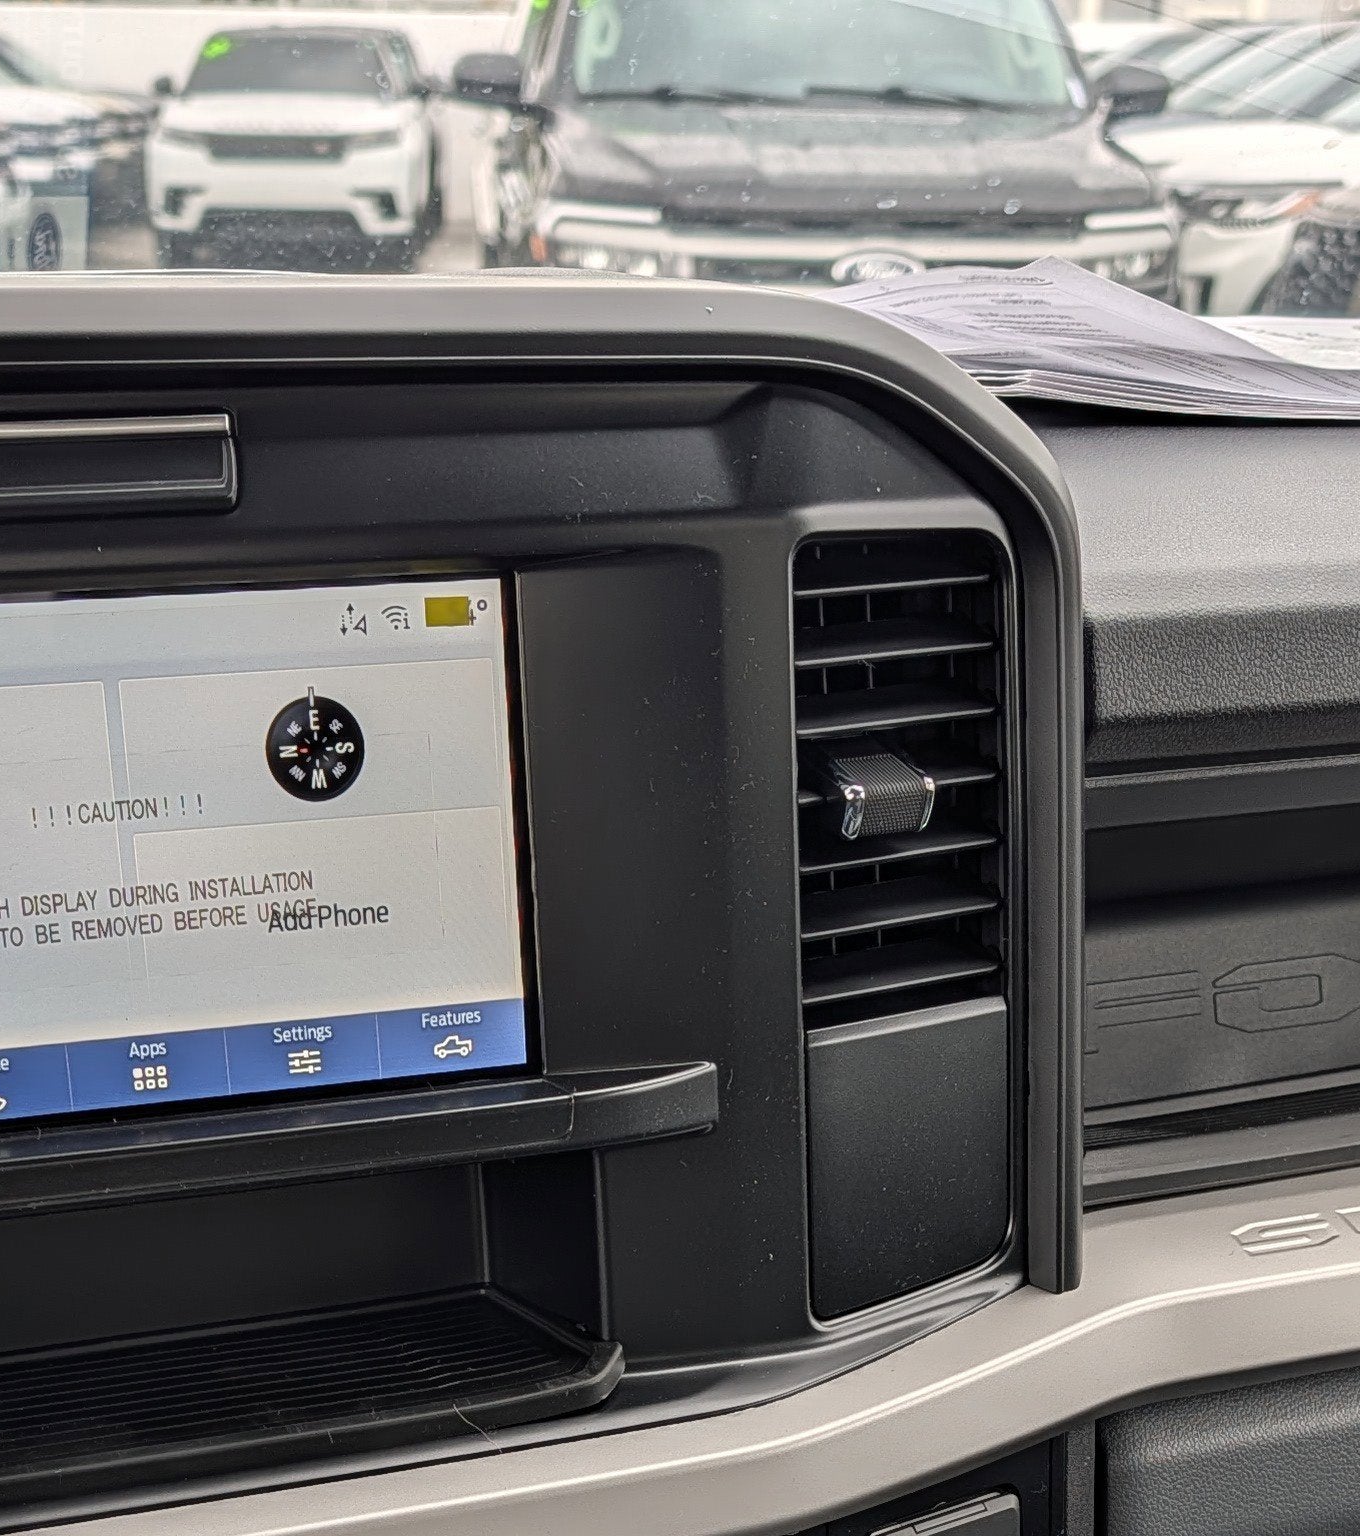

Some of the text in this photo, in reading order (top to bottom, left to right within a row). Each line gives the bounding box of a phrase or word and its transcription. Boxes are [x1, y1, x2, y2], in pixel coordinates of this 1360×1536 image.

[308, 709, 320, 731] E
[278, 745, 299, 759] N
[334, 741, 355, 754] S
[311, 768, 328, 790] W
[21, 890, 97, 918] DISPLAY
[109, 881, 179, 909] DURING
[188, 870, 314, 902] INSTALLATION
[35, 921, 61, 945] BE
[72, 911, 163, 942] REMOVED
[174, 905, 247, 931] BEFORE
[268, 903, 389, 933] Add Phone
[421, 1009, 481, 1029] Features
[273, 1024, 333, 1044] Settings
[129, 1040, 167, 1060] Apps
